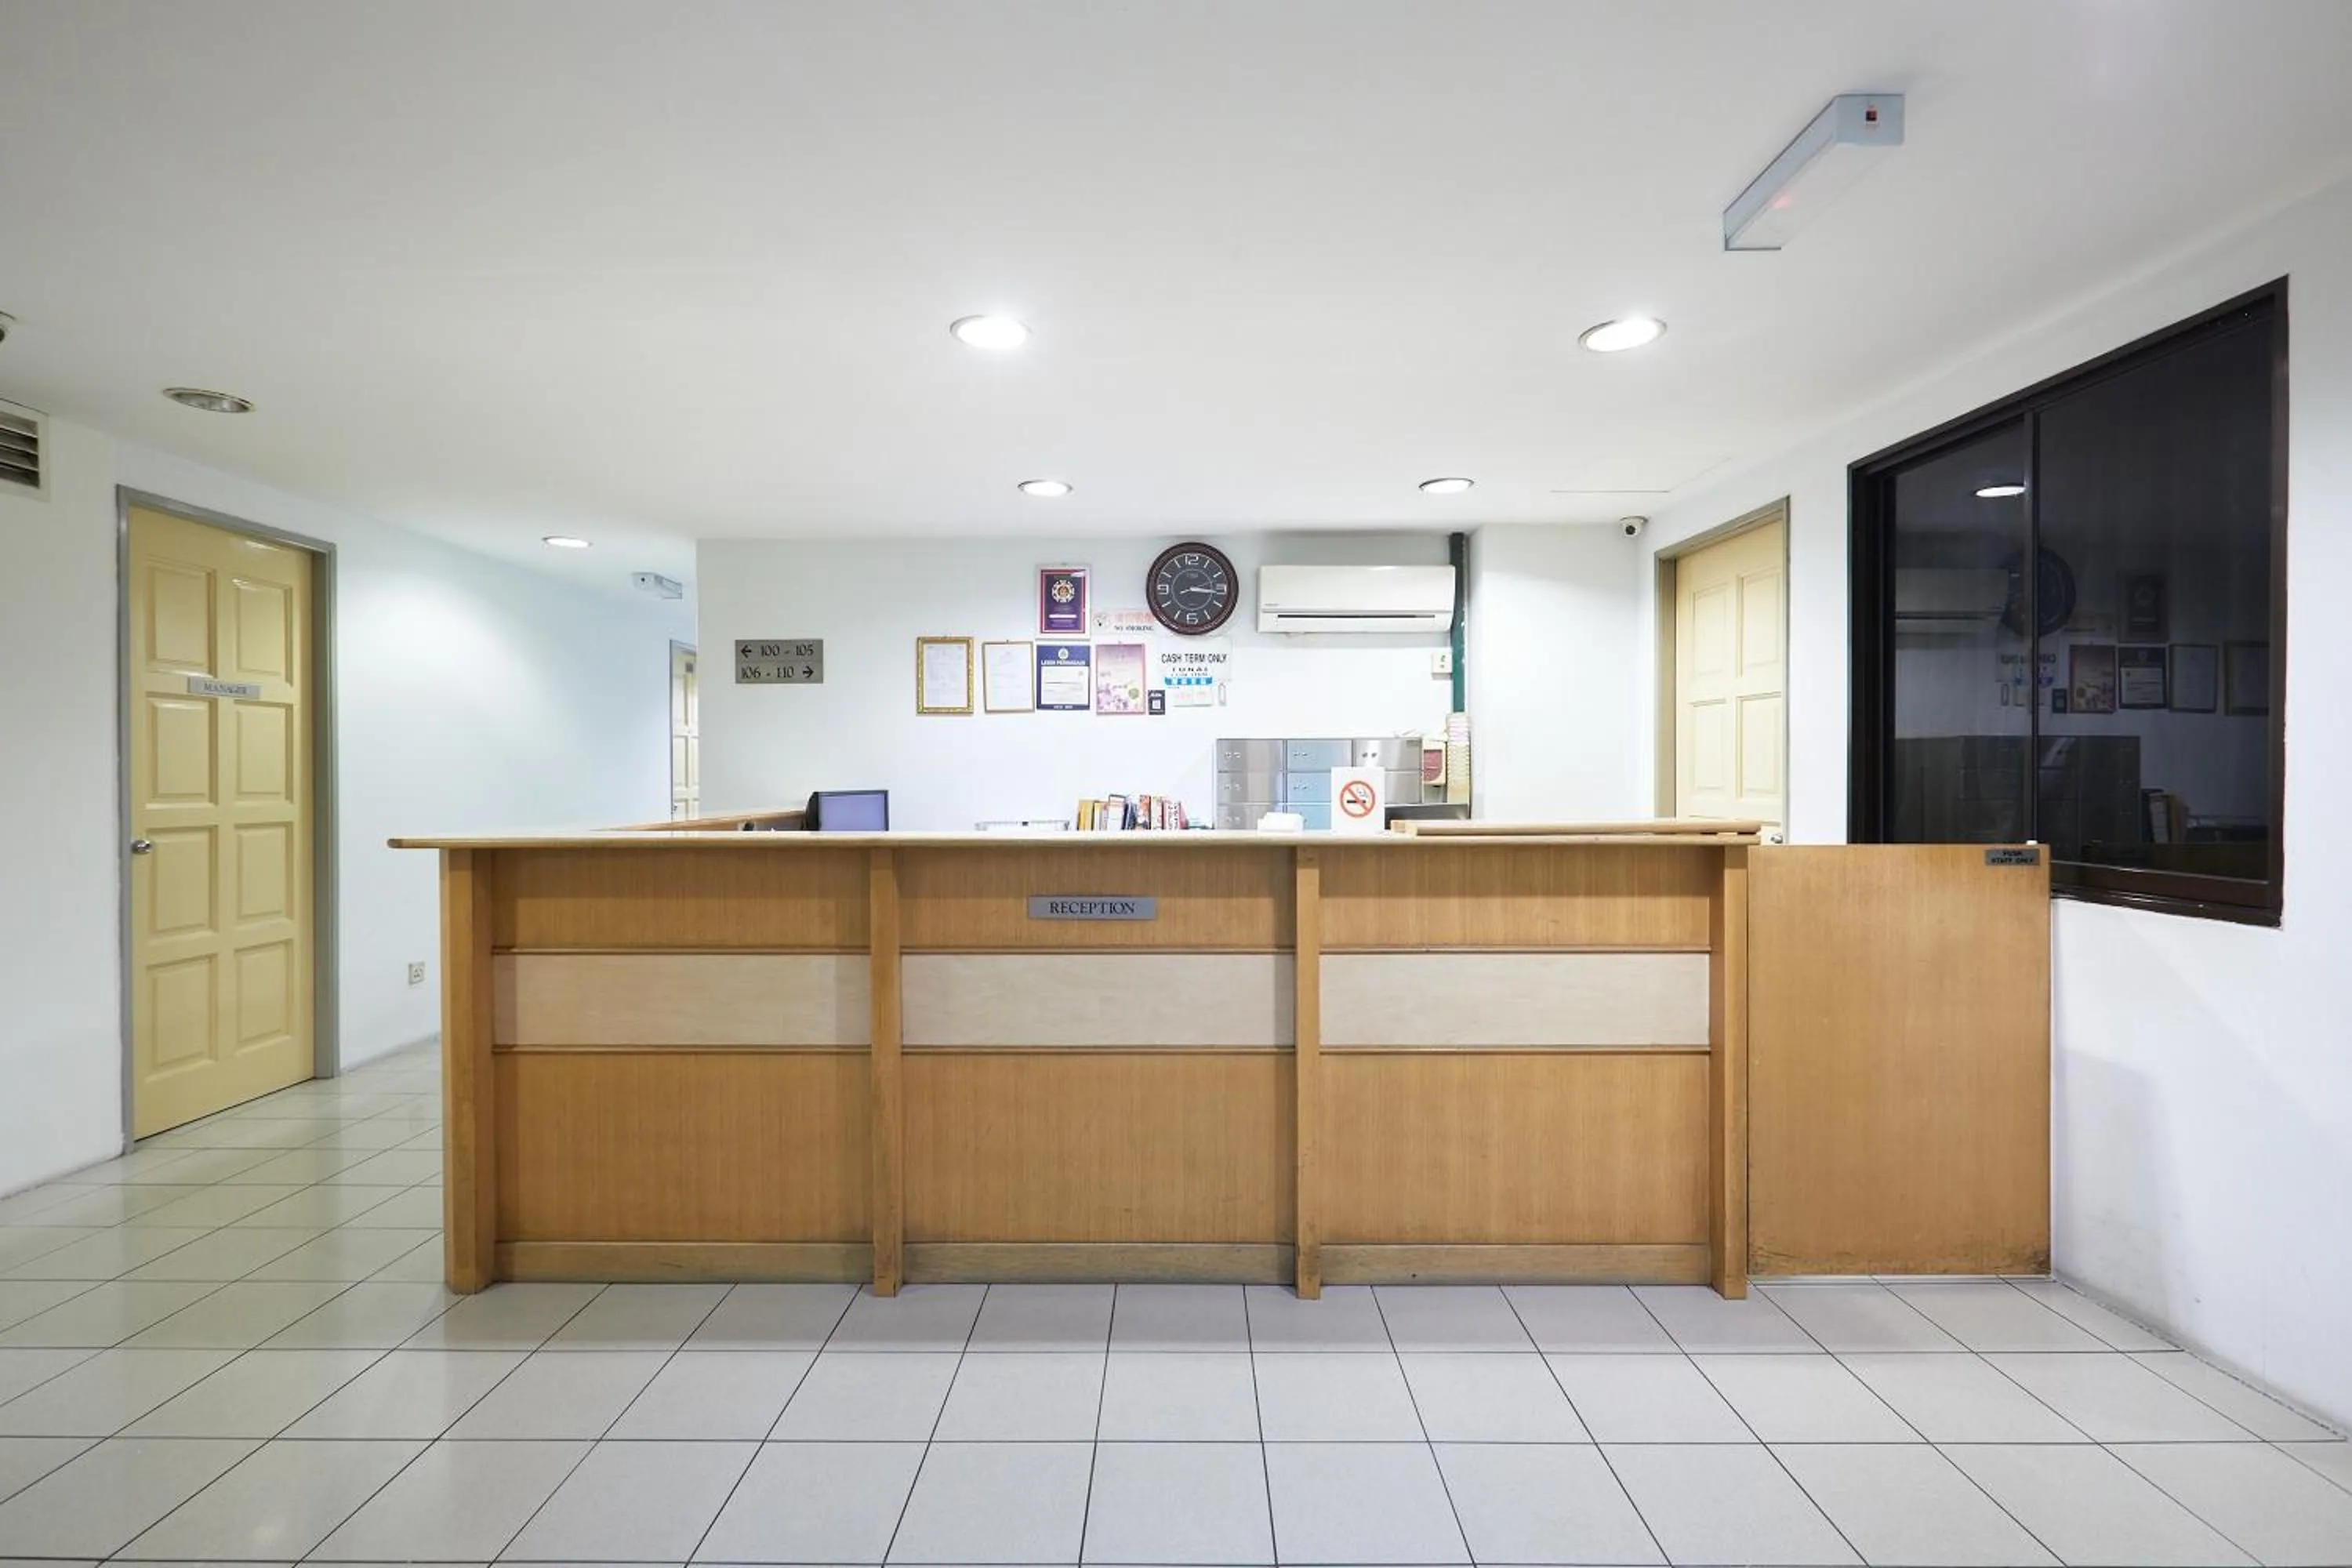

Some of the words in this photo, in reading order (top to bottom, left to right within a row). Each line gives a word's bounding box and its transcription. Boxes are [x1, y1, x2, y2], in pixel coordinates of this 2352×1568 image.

[1185, 555, 1199, 565] 12
[1157, 584, 1169, 595] 9
[1186, 612, 1198, 625] 6
[760, 645, 780, 655] 100
[796, 644, 814, 655] 105
[1161, 653, 1182, 664] CASH
[1185, 653, 1205, 664] TERM
[1207, 653, 1227, 664] ONLY
[741, 667, 760, 678] 106
[777, 666, 794, 678] 110
[1050, 902, 1135, 914] RECEPTION
